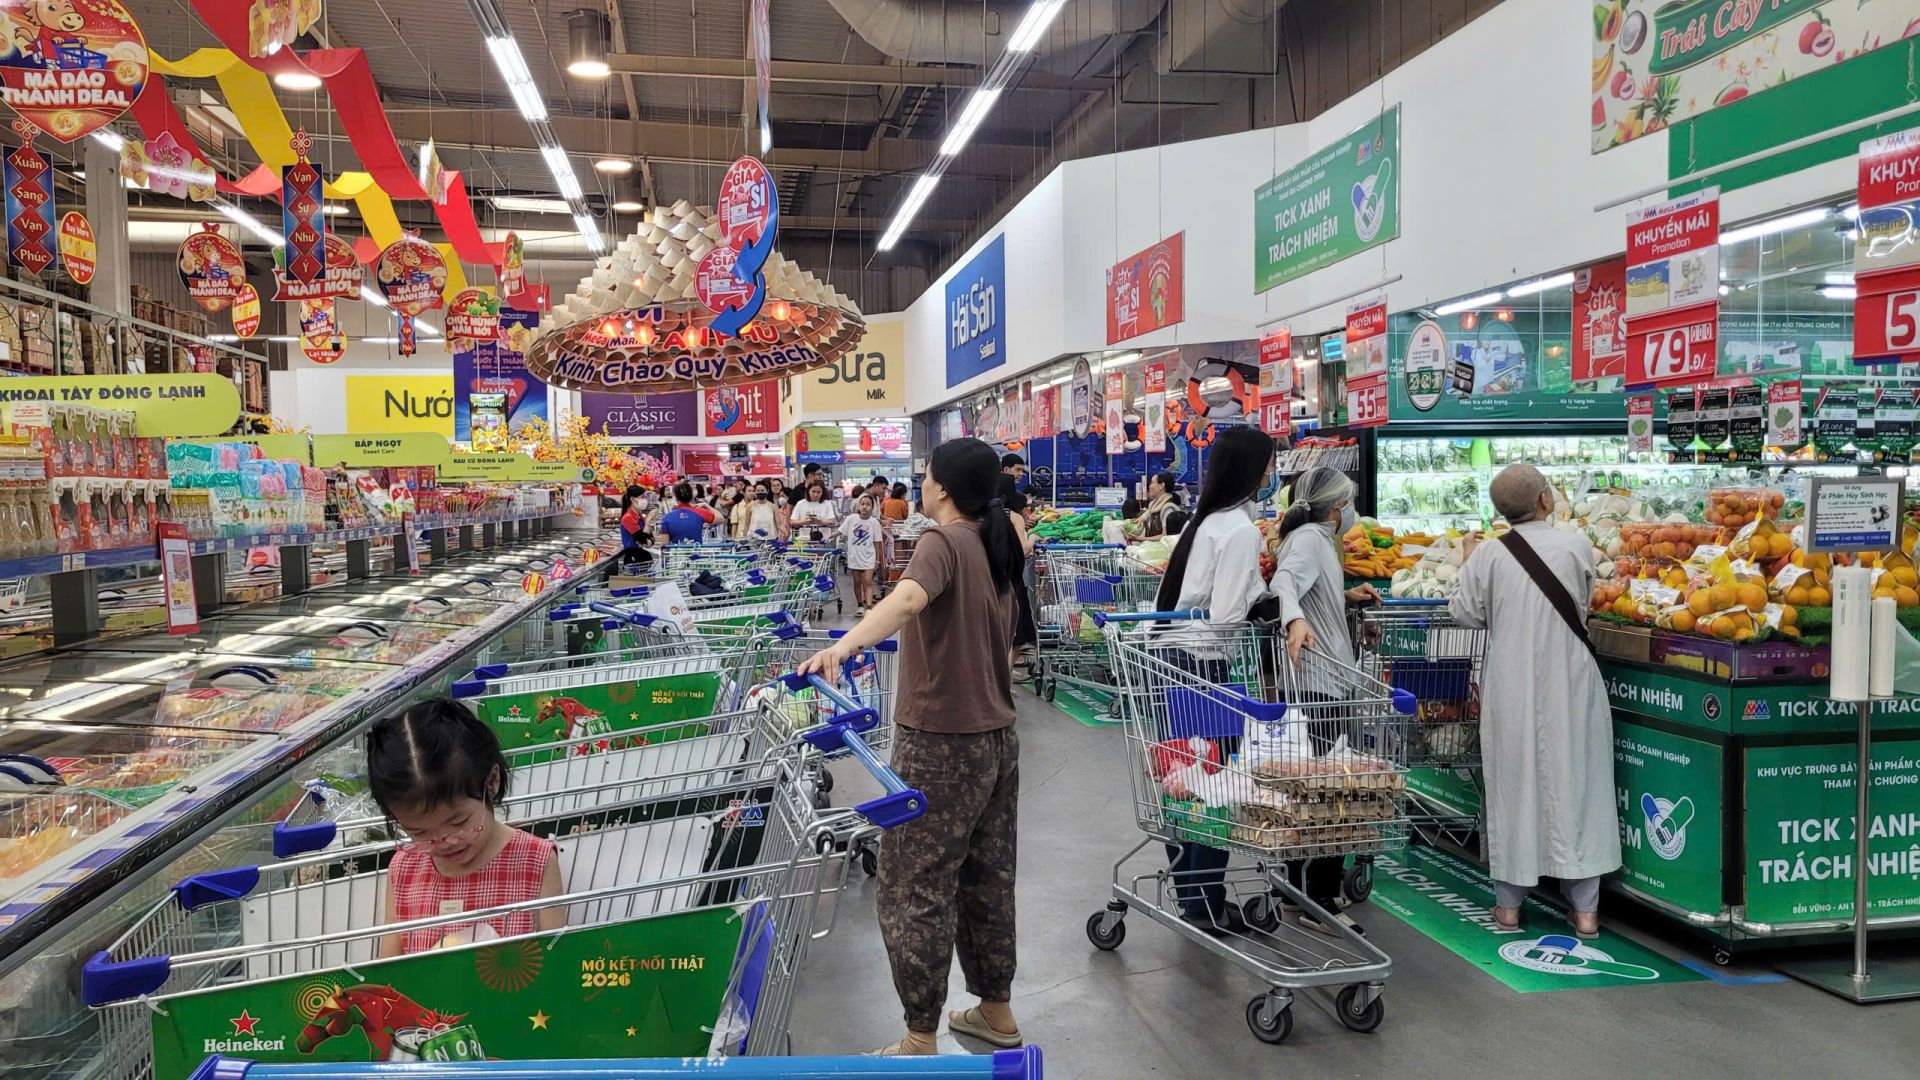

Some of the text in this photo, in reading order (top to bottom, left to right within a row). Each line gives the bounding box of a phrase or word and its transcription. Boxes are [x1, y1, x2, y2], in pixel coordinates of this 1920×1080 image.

[1660, 14, 1707, 60] Trái
[1, 87, 131, 106] THÀNH DEAL
[14, 154, 43, 170] Xuân
[294, 172, 311, 184] Vạn
[16, 187, 43, 204] Sang
[298, 203, 309, 216] Sự
[1274, 187, 1330, 232] TICK XANH
[20, 217, 43, 232] Vạn
[1634, 210, 1710, 247] KHUYẾN MÃI
[295, 232, 315, 243] Như
[1268, 215, 1338, 264] TRÁCH NHIỆM
[1651, 237, 1690, 255] Promotion
[20, 249, 47, 263] Phúc
[303, 259, 309, 273] Ý
[447, 314, 496, 326] CHÚC MỪNG
[1649, 330, 1685, 376] 79
[553, 343, 817, 384] Kính Chào Quý Khách
[0, 384, 206, 401] KHOAI TÂY ĐÔNG LẠNH
[867, 388, 886, 401] Milk
[735, 386, 762, 420] hịt
[1358, 389, 1375, 418] 55
[607, 411, 676, 423] CLASSIC
[746, 420, 762, 429] Meat
[1269, 404, 1281, 430] 15
[628, 423, 655, 434] Corner
[376, 440, 402, 449] NGỌT
[1860, 491, 1874, 499] Sinh
[1875, 491, 1887, 499] Học
[652, 697, 673, 705] 2026
[1604, 677, 1683, 713] RÁCH NHIỆM
[1779, 700, 1818, 717] TICK
[498, 715, 531, 724] Heineken
[1621, 738, 1636, 751] CỦA
[1637, 743, 1662, 758] DOANH
[1663, 751, 1690, 768] NGHIỆP
[1625, 754, 1644, 768] TRÌNH
[1757, 767, 1778, 778] KHU
[1780, 765, 1802, 779] VỰC
[1805, 763, 1838, 775] TRƯNG
[1884, 756, 1913, 771] PHẨM
[1823, 774, 1919, 790] THAM CHƯƠNG
[1778, 817, 1841, 845] TICK
[1372, 854, 1446, 892] TRÁCH
[1758, 850, 1851, 885] TRÁCH
[1792, 896, 1904, 914] BỀN VỮNG AN TRÁCH
[582, 954, 705, 972] MỞ KẾT NỐI THẬT
[581, 972, 631, 987] 2026
[204, 1037, 284, 1053] Heineken
